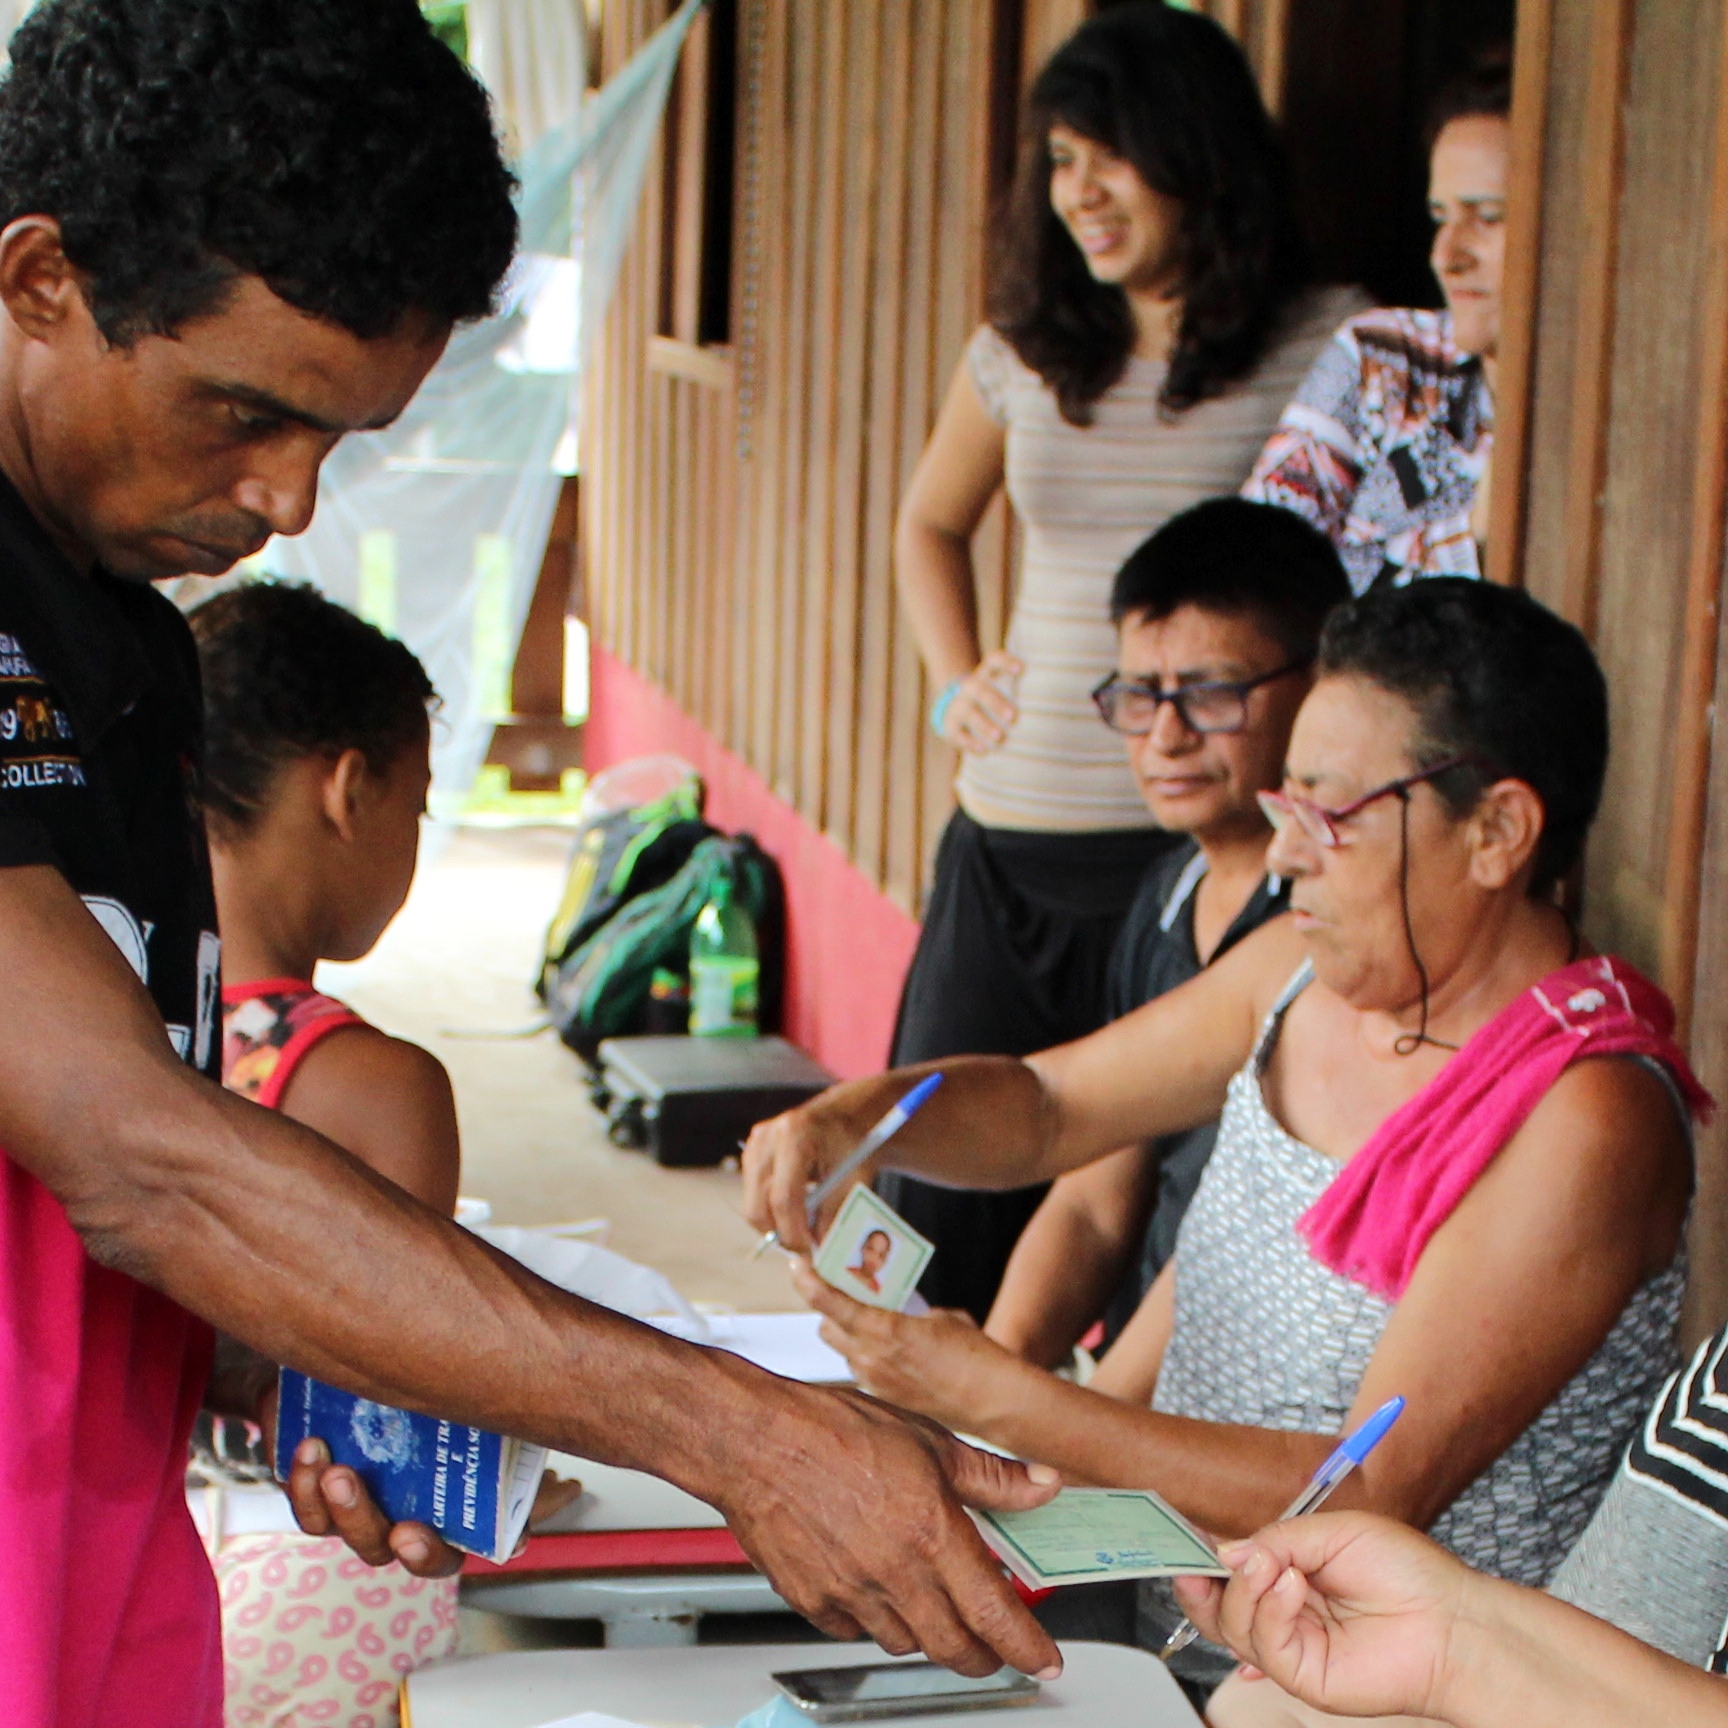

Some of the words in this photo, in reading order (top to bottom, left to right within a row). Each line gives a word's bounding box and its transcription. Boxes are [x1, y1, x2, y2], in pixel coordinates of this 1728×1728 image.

[434, 1445, 449, 1464] DE
[450, 1451, 464, 1463] E
[429, 1465, 452, 1528] CARTEIRA
[457, 1445, 484, 1529] PREVIDÊNCIA
